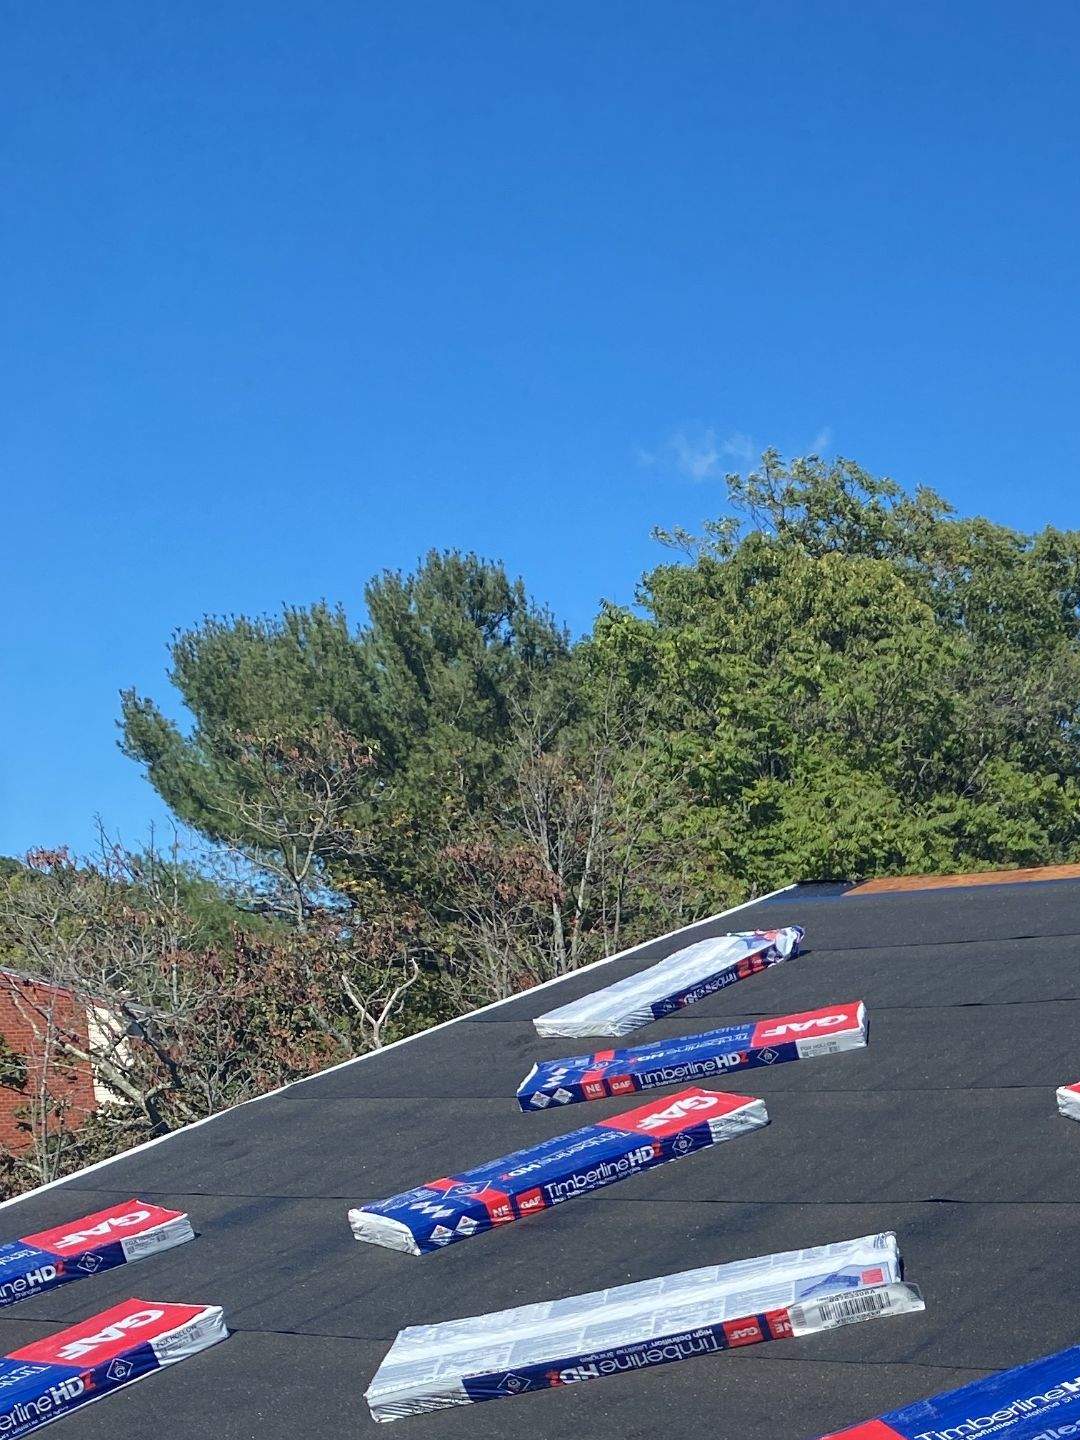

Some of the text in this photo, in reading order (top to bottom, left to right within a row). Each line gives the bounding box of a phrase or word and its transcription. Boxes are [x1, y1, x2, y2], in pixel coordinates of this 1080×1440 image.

[761, 1013, 849, 1038] GAF
[612, 1081, 631, 1091] GAF
[636, 1095, 719, 1131] GAF
[520, 1196, 541, 1210] GAF
[53, 1210, 151, 1249] GAF
[56, 1309, 165, 1360] GAF
[729, 1325, 761, 1340] GAF
